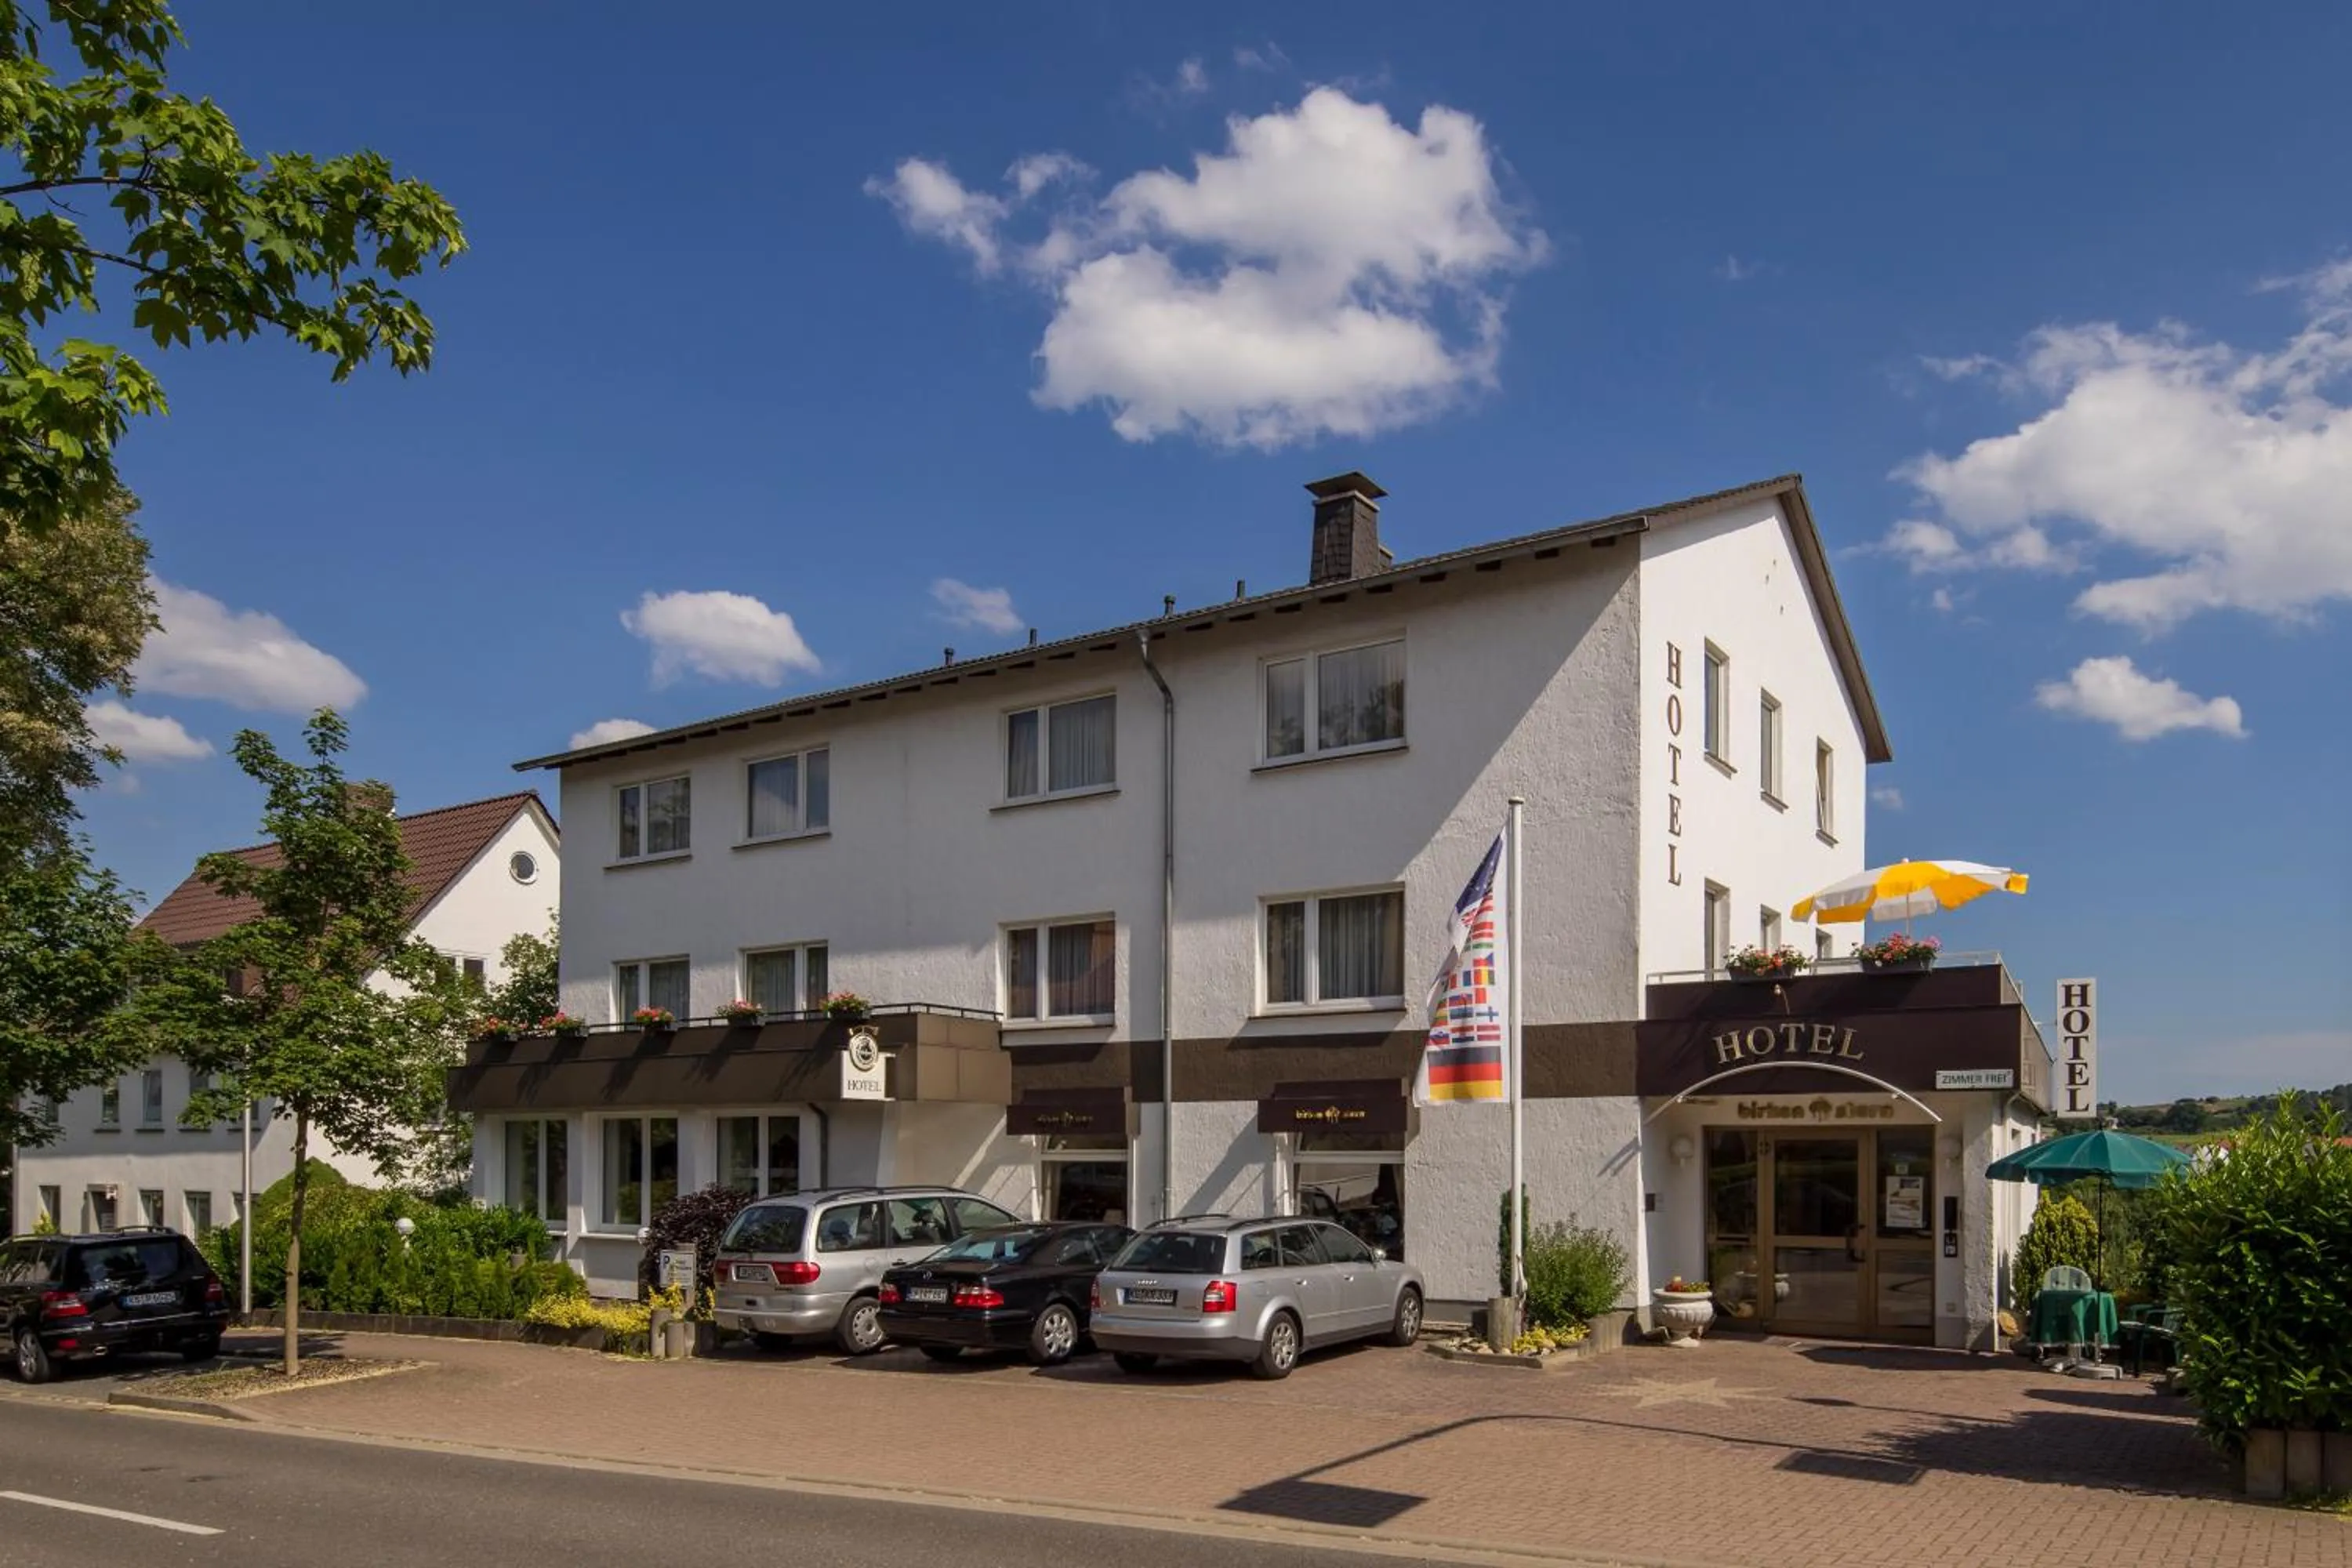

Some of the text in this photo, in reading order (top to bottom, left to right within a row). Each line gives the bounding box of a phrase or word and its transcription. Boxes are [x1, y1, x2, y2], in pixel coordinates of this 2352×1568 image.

[1667, 641, 1682, 887] HOTEL
[847, 1080, 882, 1092] HOTEL
[1712, 1022, 1864, 1064] HOTEL
[2062, 983, 2091, 1113] HOTEL
